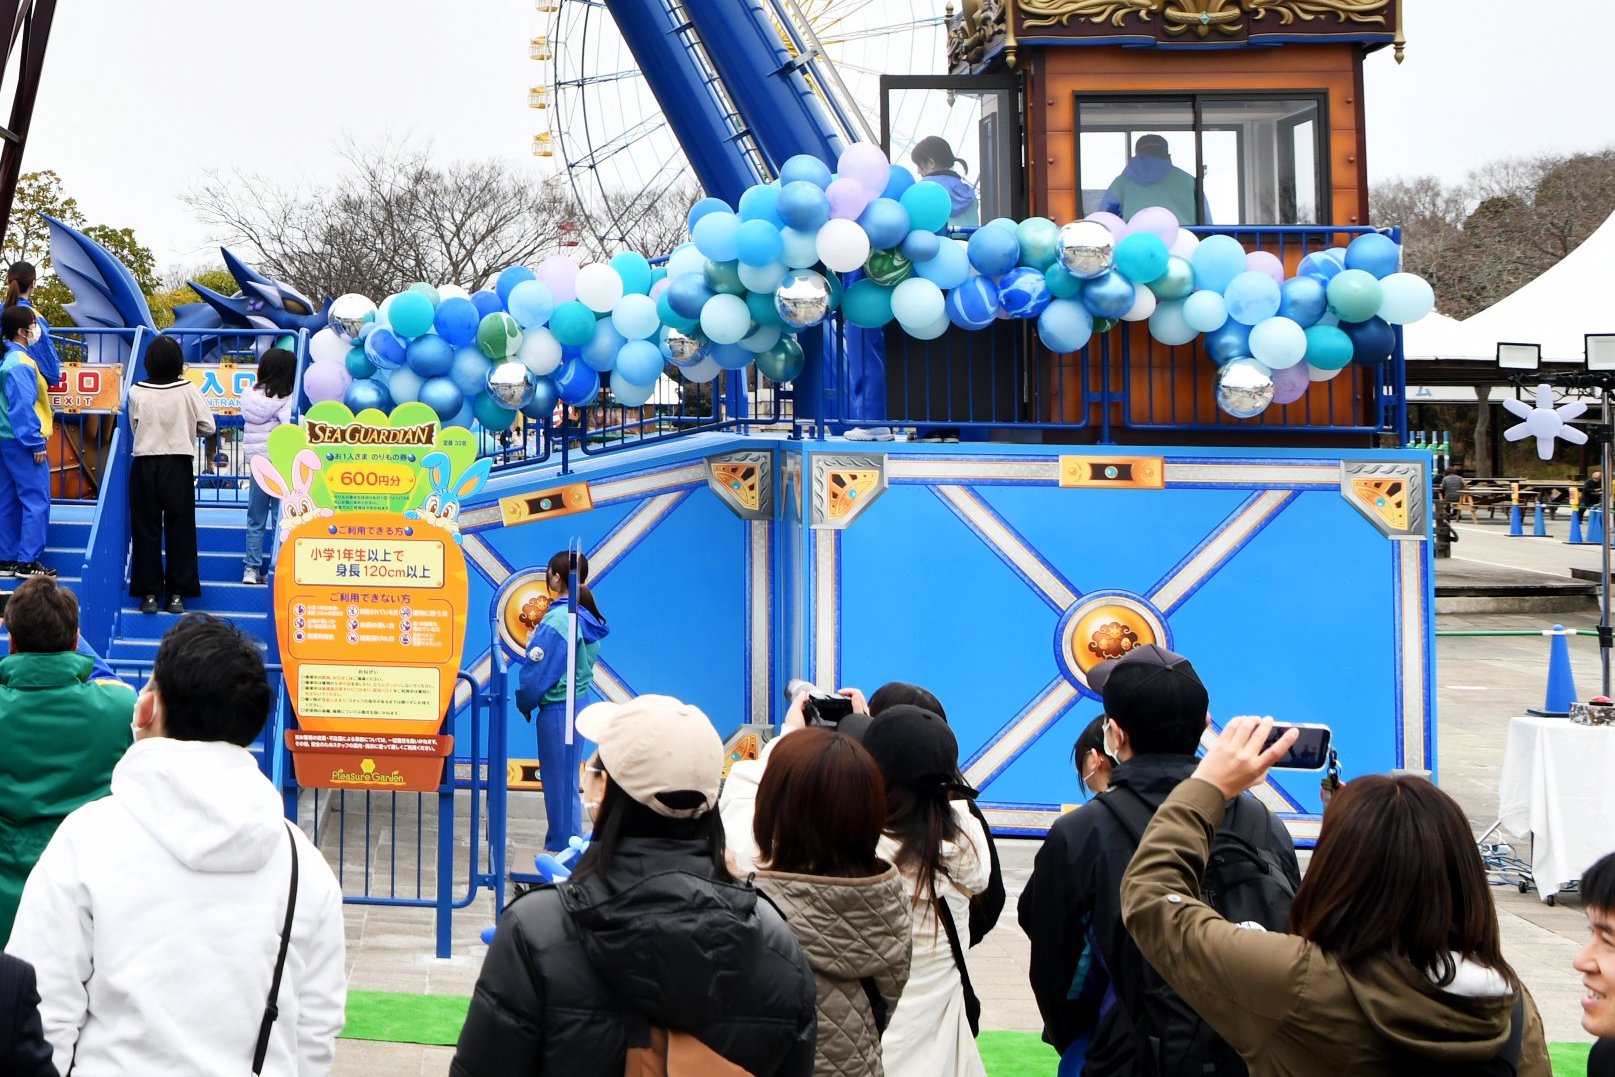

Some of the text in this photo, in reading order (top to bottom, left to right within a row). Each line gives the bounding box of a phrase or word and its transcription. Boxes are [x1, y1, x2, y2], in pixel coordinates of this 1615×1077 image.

[53, 396, 93, 406] EXIT
[207, 397, 242, 407] NTRAN
[312, 424, 429, 444] SEA GUARDIAN
[340, 471, 401, 487] 600円分
[339, 525, 404, 536] ご利用できる方
[310, 547, 405, 562] 小学1年生以上で
[330, 592, 411, 605] ご利用できない方
[332, 769, 404, 782] Pleasure Garden
